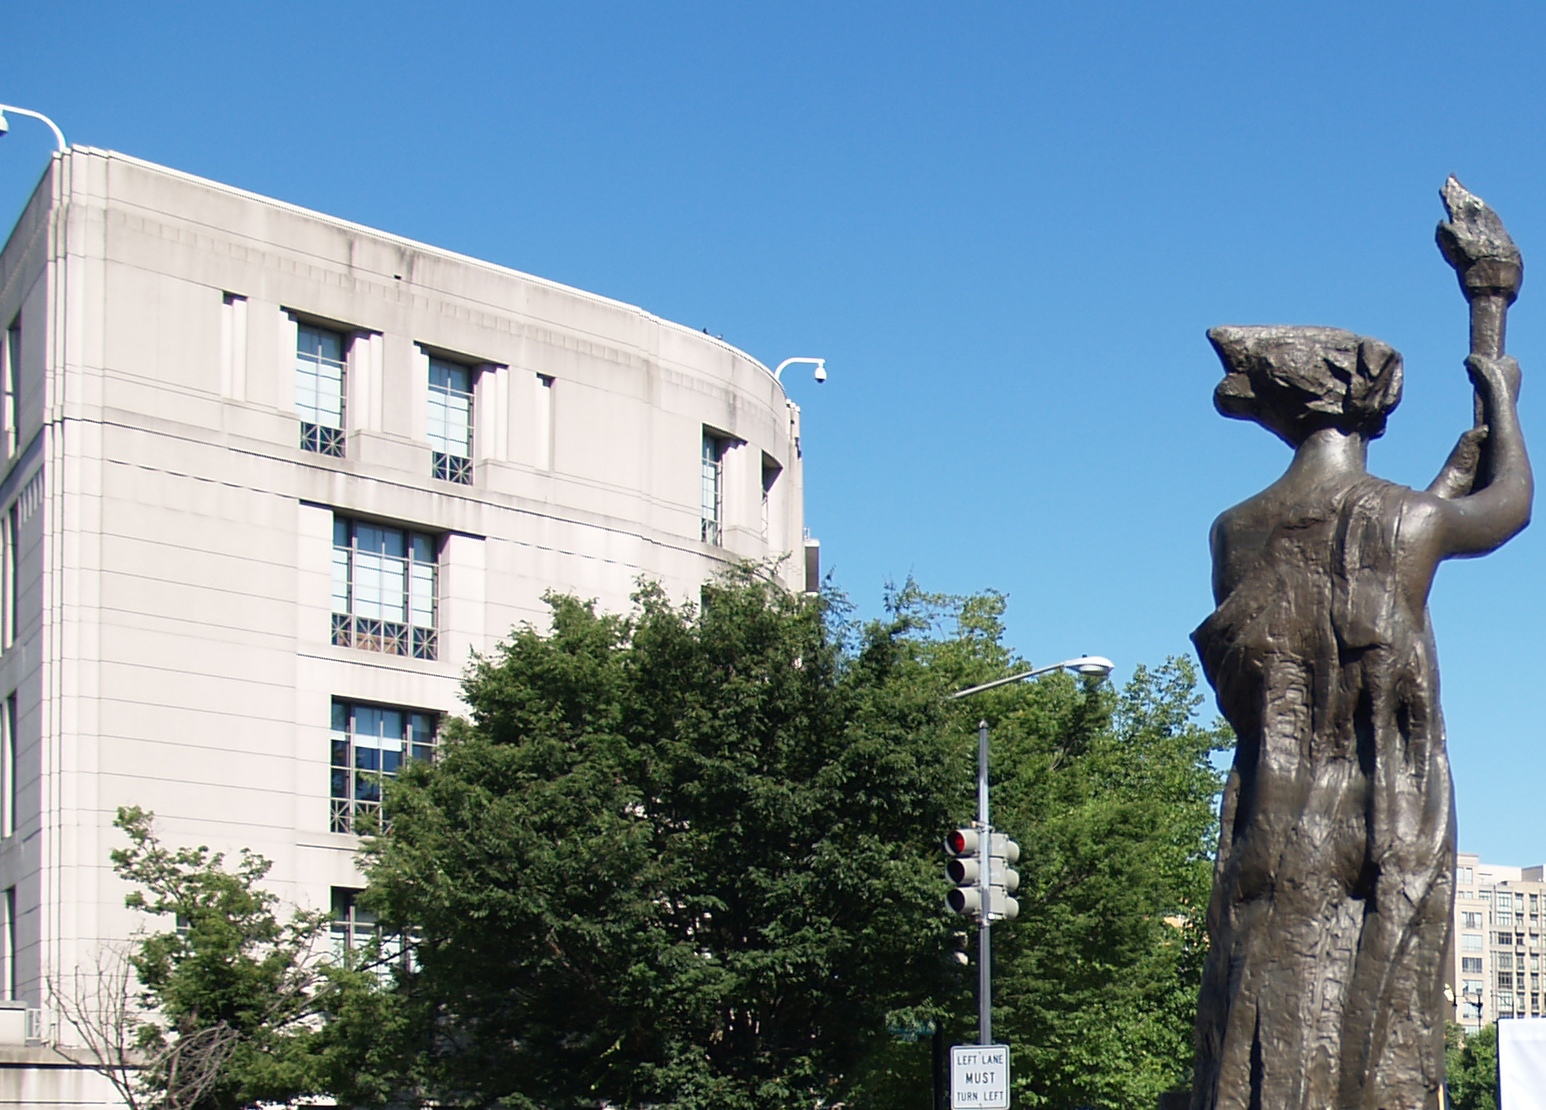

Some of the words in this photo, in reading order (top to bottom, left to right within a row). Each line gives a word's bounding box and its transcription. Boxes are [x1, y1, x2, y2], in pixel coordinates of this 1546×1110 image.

[957, 1055, 977, 1066] LEFT
[981, 1054, 1004, 1065] LANE
[965, 1072, 995, 1084] MUST
[957, 1091, 978, 1103] TURN
[983, 1091, 1004, 1101] LEFT
